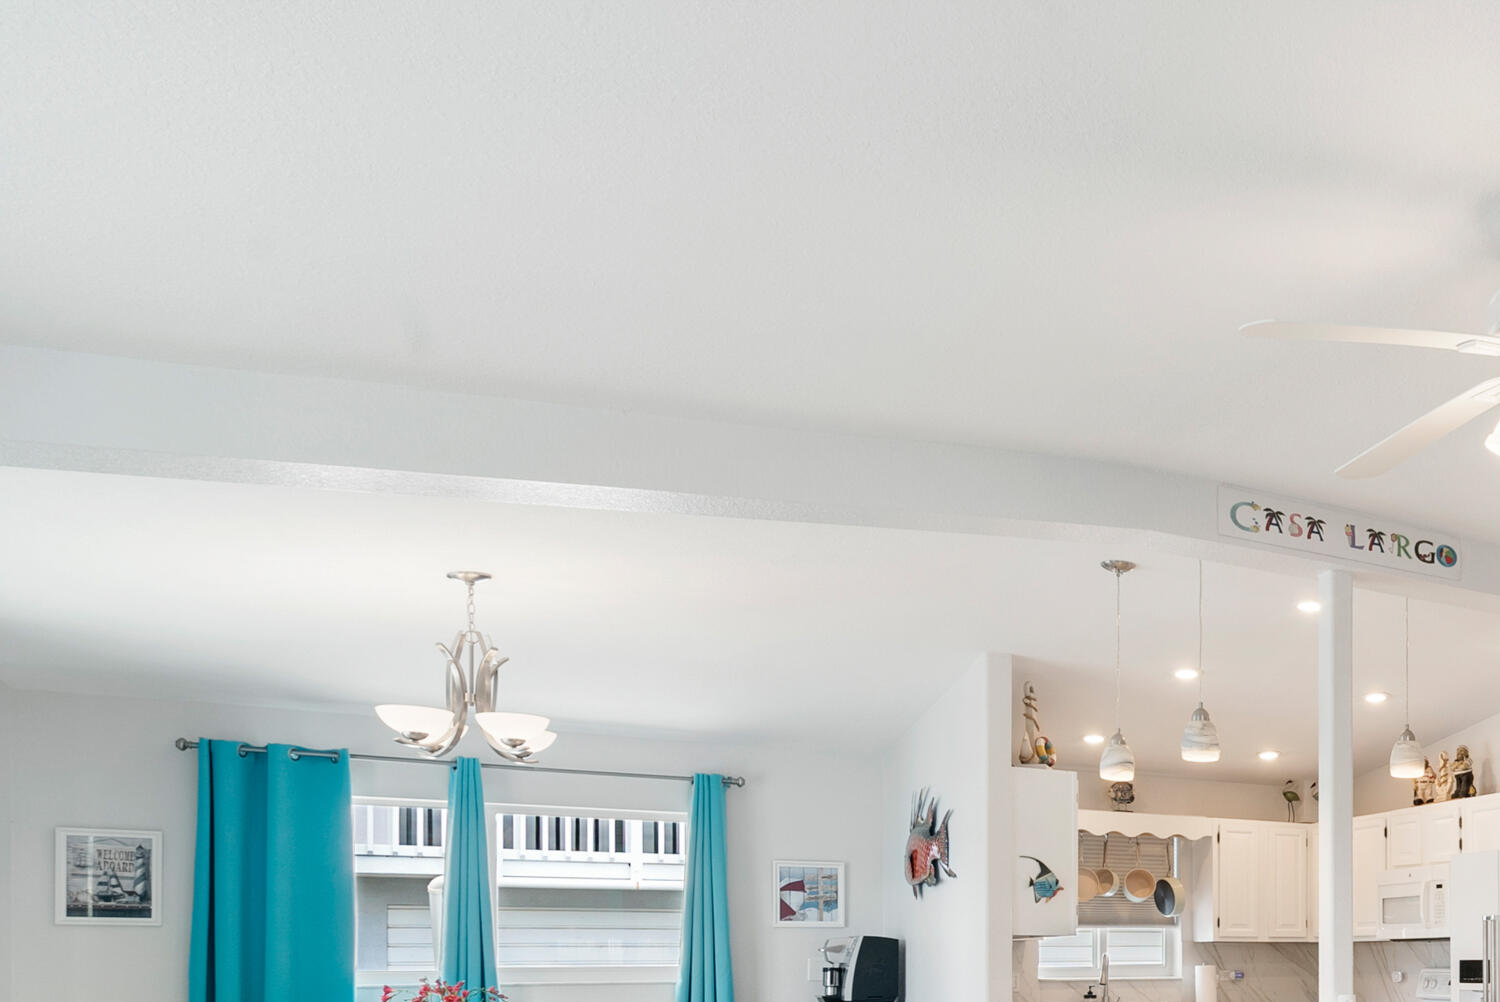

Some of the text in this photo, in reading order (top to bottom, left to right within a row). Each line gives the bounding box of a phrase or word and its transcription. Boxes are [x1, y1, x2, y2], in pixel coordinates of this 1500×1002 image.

[1229, 501, 1458, 568] CASA LARGO
[96, 849, 136, 861] WELCOME
